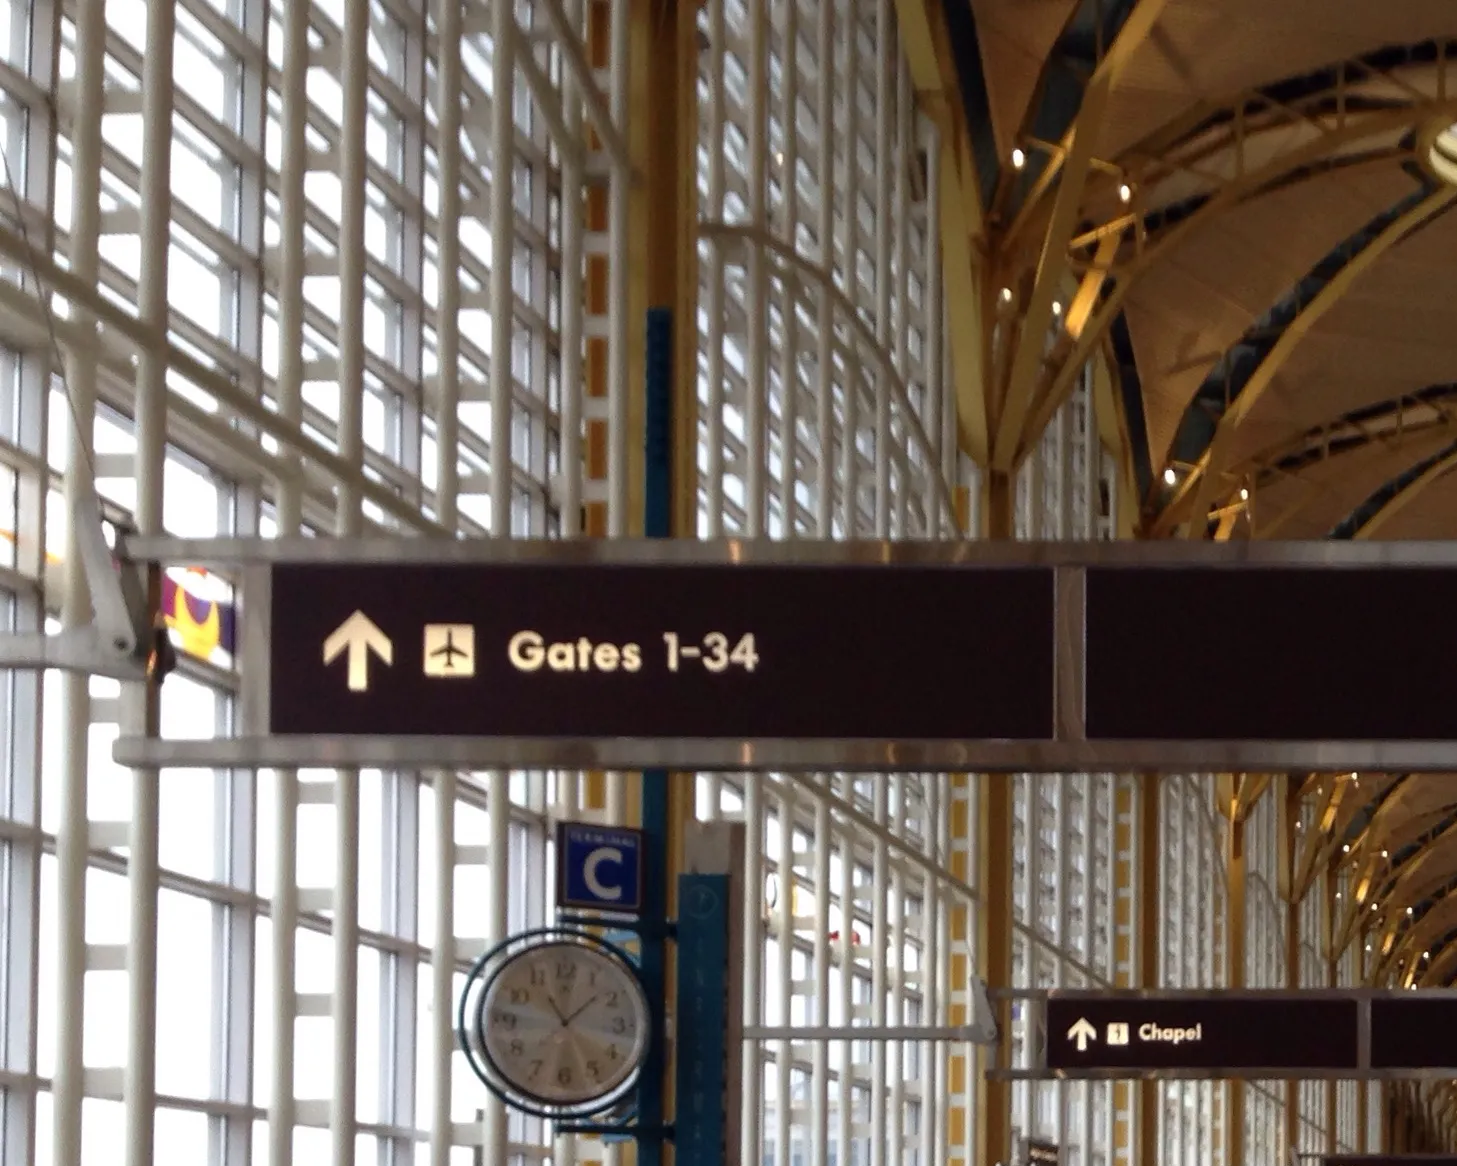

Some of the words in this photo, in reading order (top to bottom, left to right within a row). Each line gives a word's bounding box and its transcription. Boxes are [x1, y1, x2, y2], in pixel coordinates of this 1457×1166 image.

[507, 630, 643, 672] Gates
[662, 631, 760, 672] 1-34
[583, 846, 623, 900] C
[1138, 1022, 1202, 1045] Chapel
